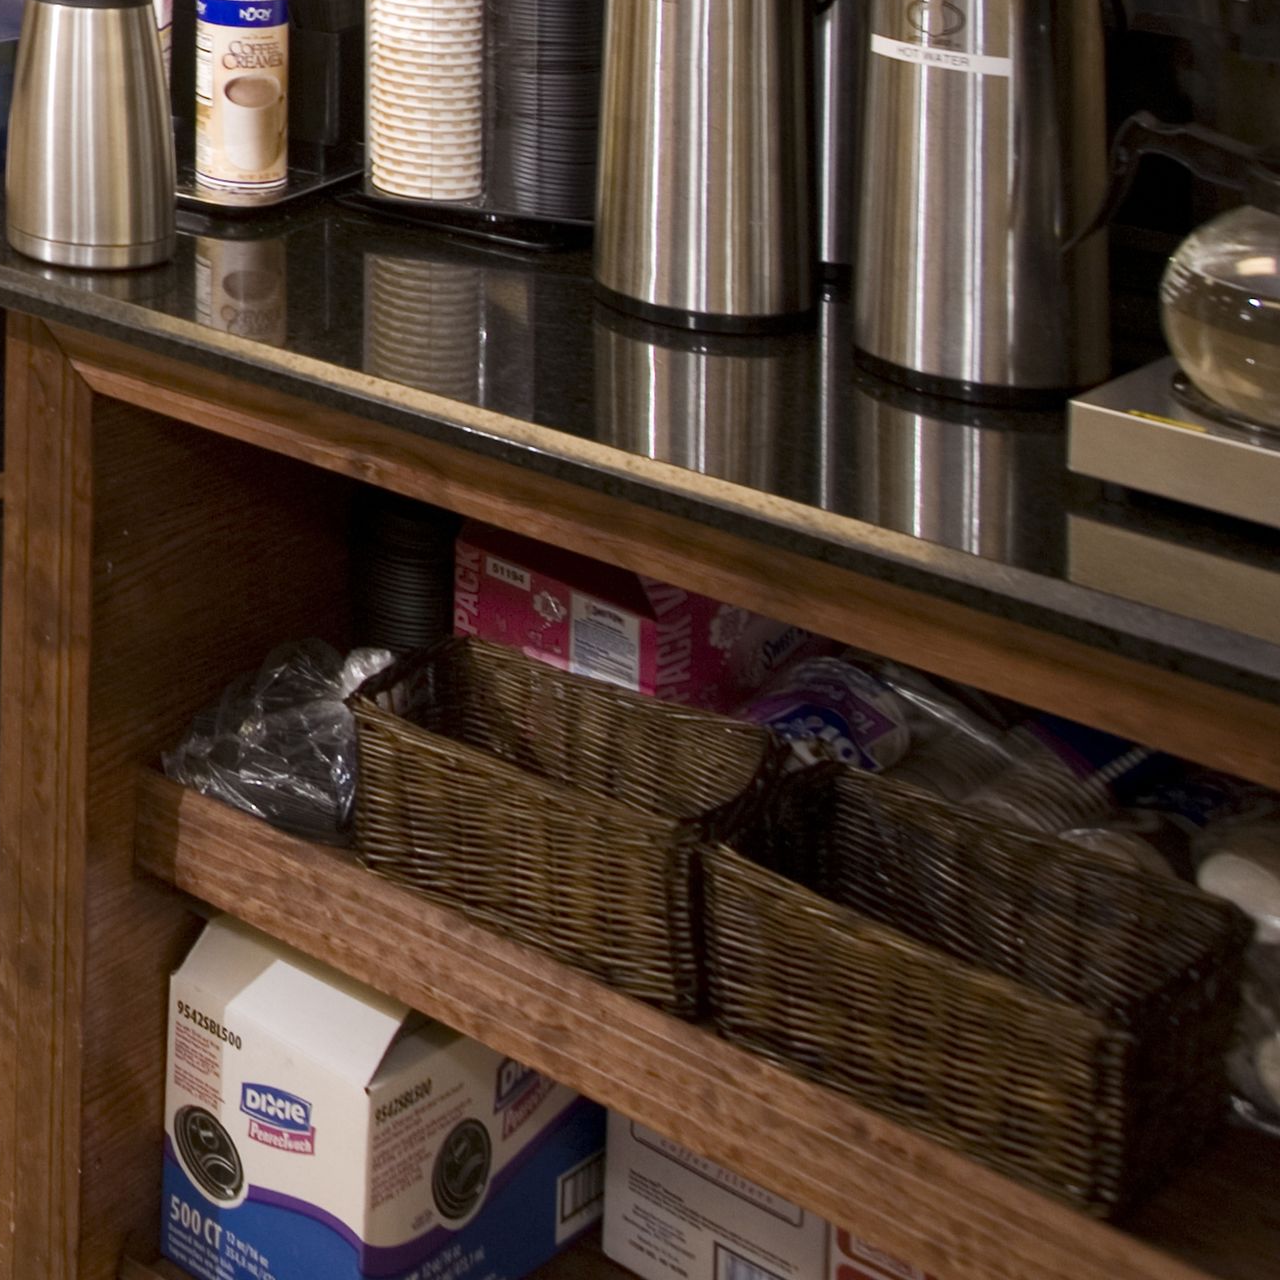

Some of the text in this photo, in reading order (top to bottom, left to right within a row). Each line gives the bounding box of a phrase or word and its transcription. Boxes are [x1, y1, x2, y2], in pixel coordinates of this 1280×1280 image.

[222, 53, 283, 70] CREAMER
[229, 41, 279, 55] COFFEE
[897, 47, 969, 66] HOT WATER
[454, 539, 481, 636] PACK
[177, 1000, 242, 1050] 9542SBL500
[170, 1194, 222, 1249] 500 CT
